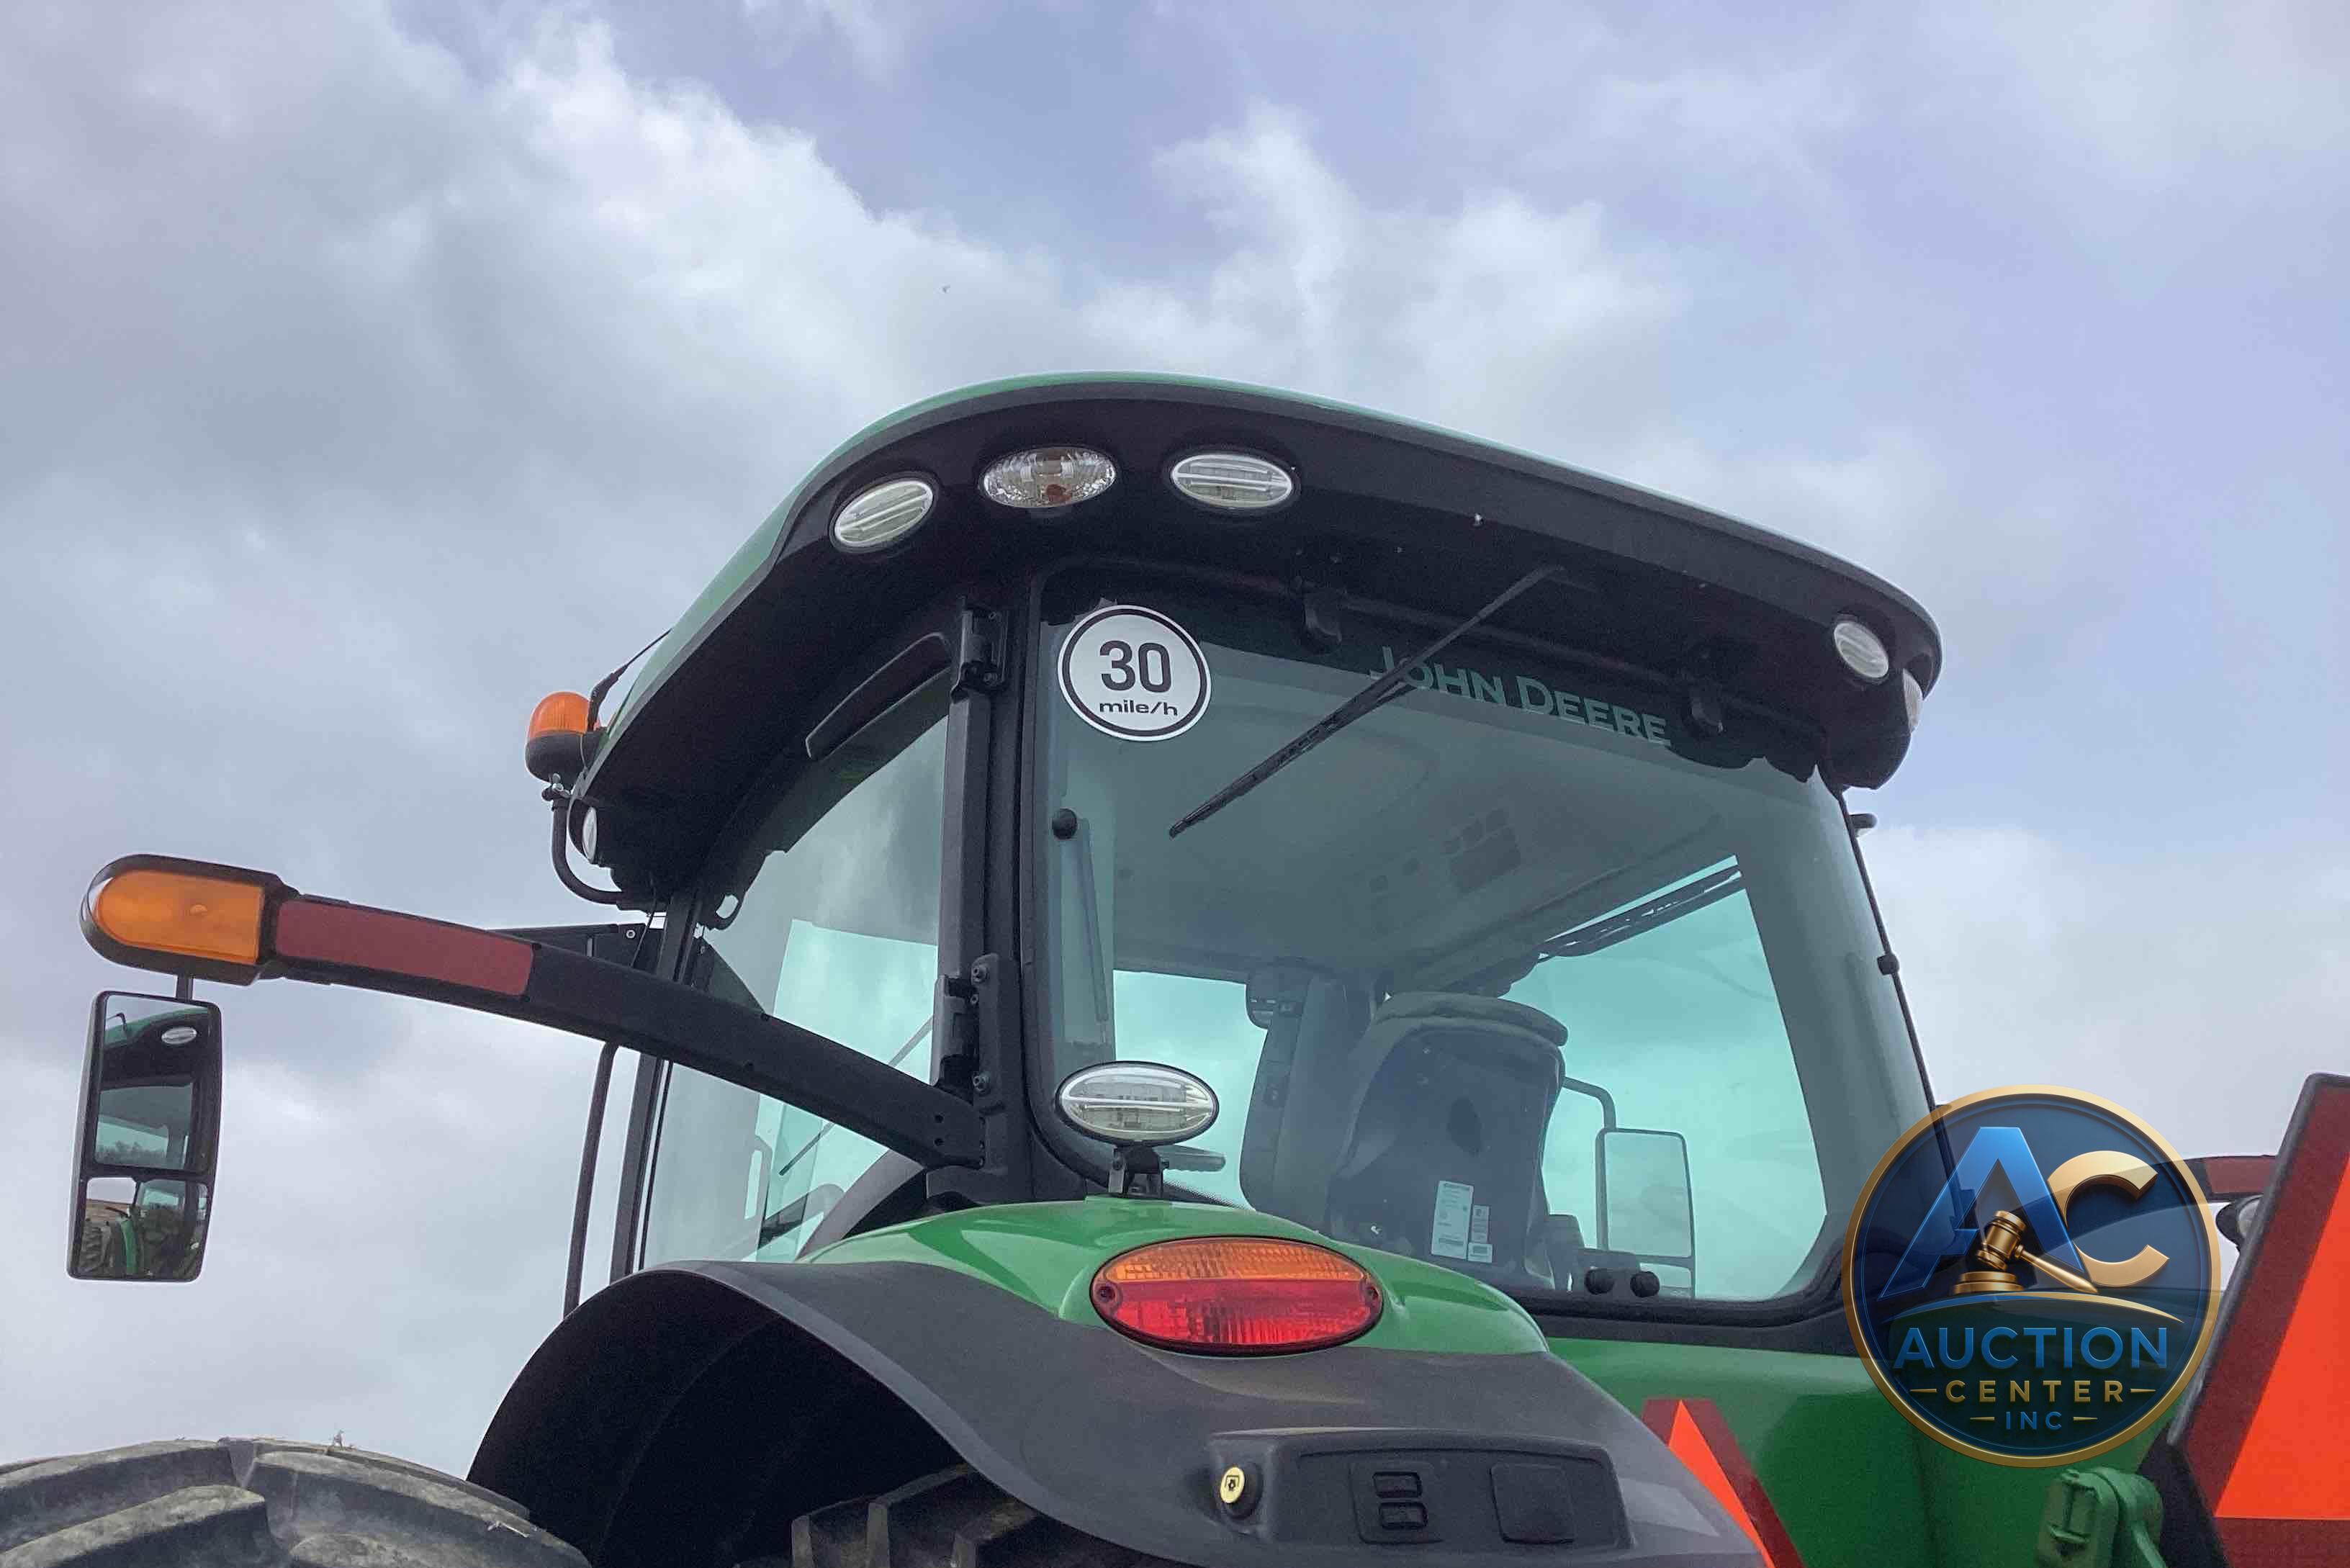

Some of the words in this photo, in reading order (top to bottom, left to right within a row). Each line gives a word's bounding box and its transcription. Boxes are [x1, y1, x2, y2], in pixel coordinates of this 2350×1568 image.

[1099, 640, 1171, 693] 30
[1099, 700, 1178, 716] mile/h
[1369, 646, 1507, 707] JOHN
[1516, 675, 1670, 746] DEERE
